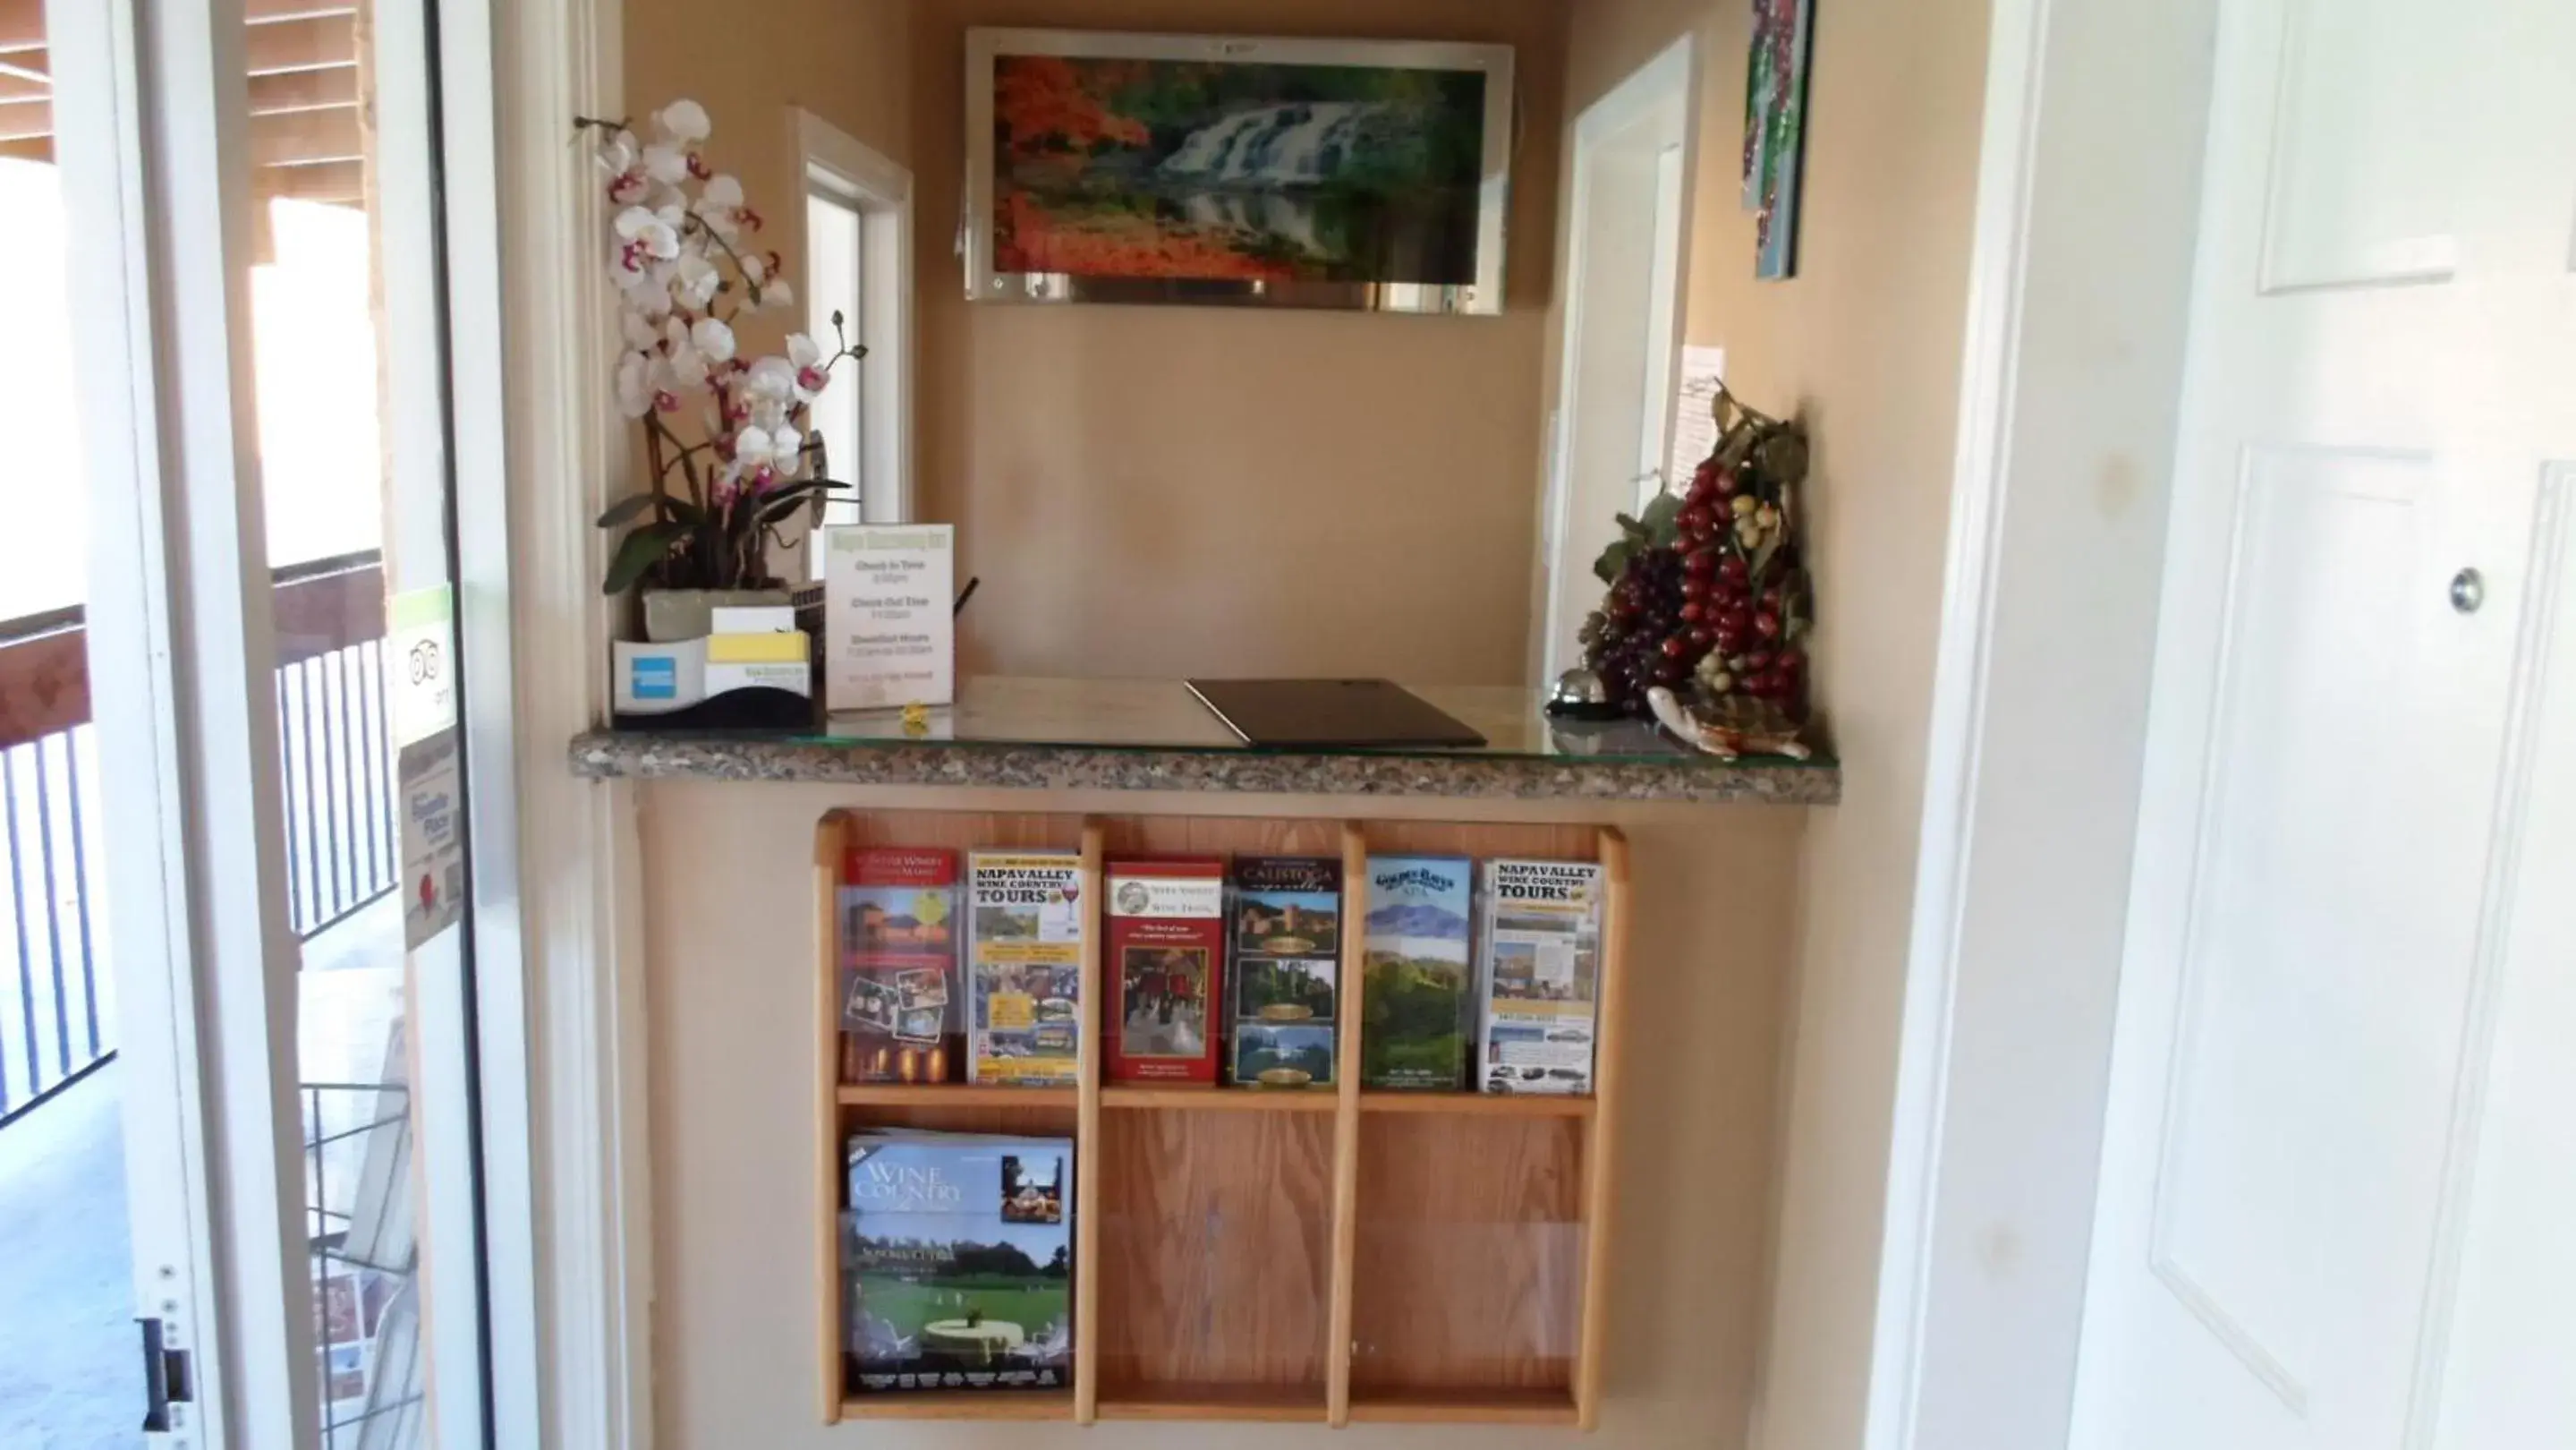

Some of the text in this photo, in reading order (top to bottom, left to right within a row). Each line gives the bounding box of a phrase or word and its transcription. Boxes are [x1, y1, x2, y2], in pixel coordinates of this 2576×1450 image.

[1243, 866, 1333, 882] CALISTOGA
[1498, 875, 1585, 886] WINE COUNTRY
[976, 880, 1062, 889] WINE COUNTRY
[1498, 883, 1568, 899] TOURS
[976, 889, 1047, 903] TOURS
[867, 1163, 942, 1183] WINE
